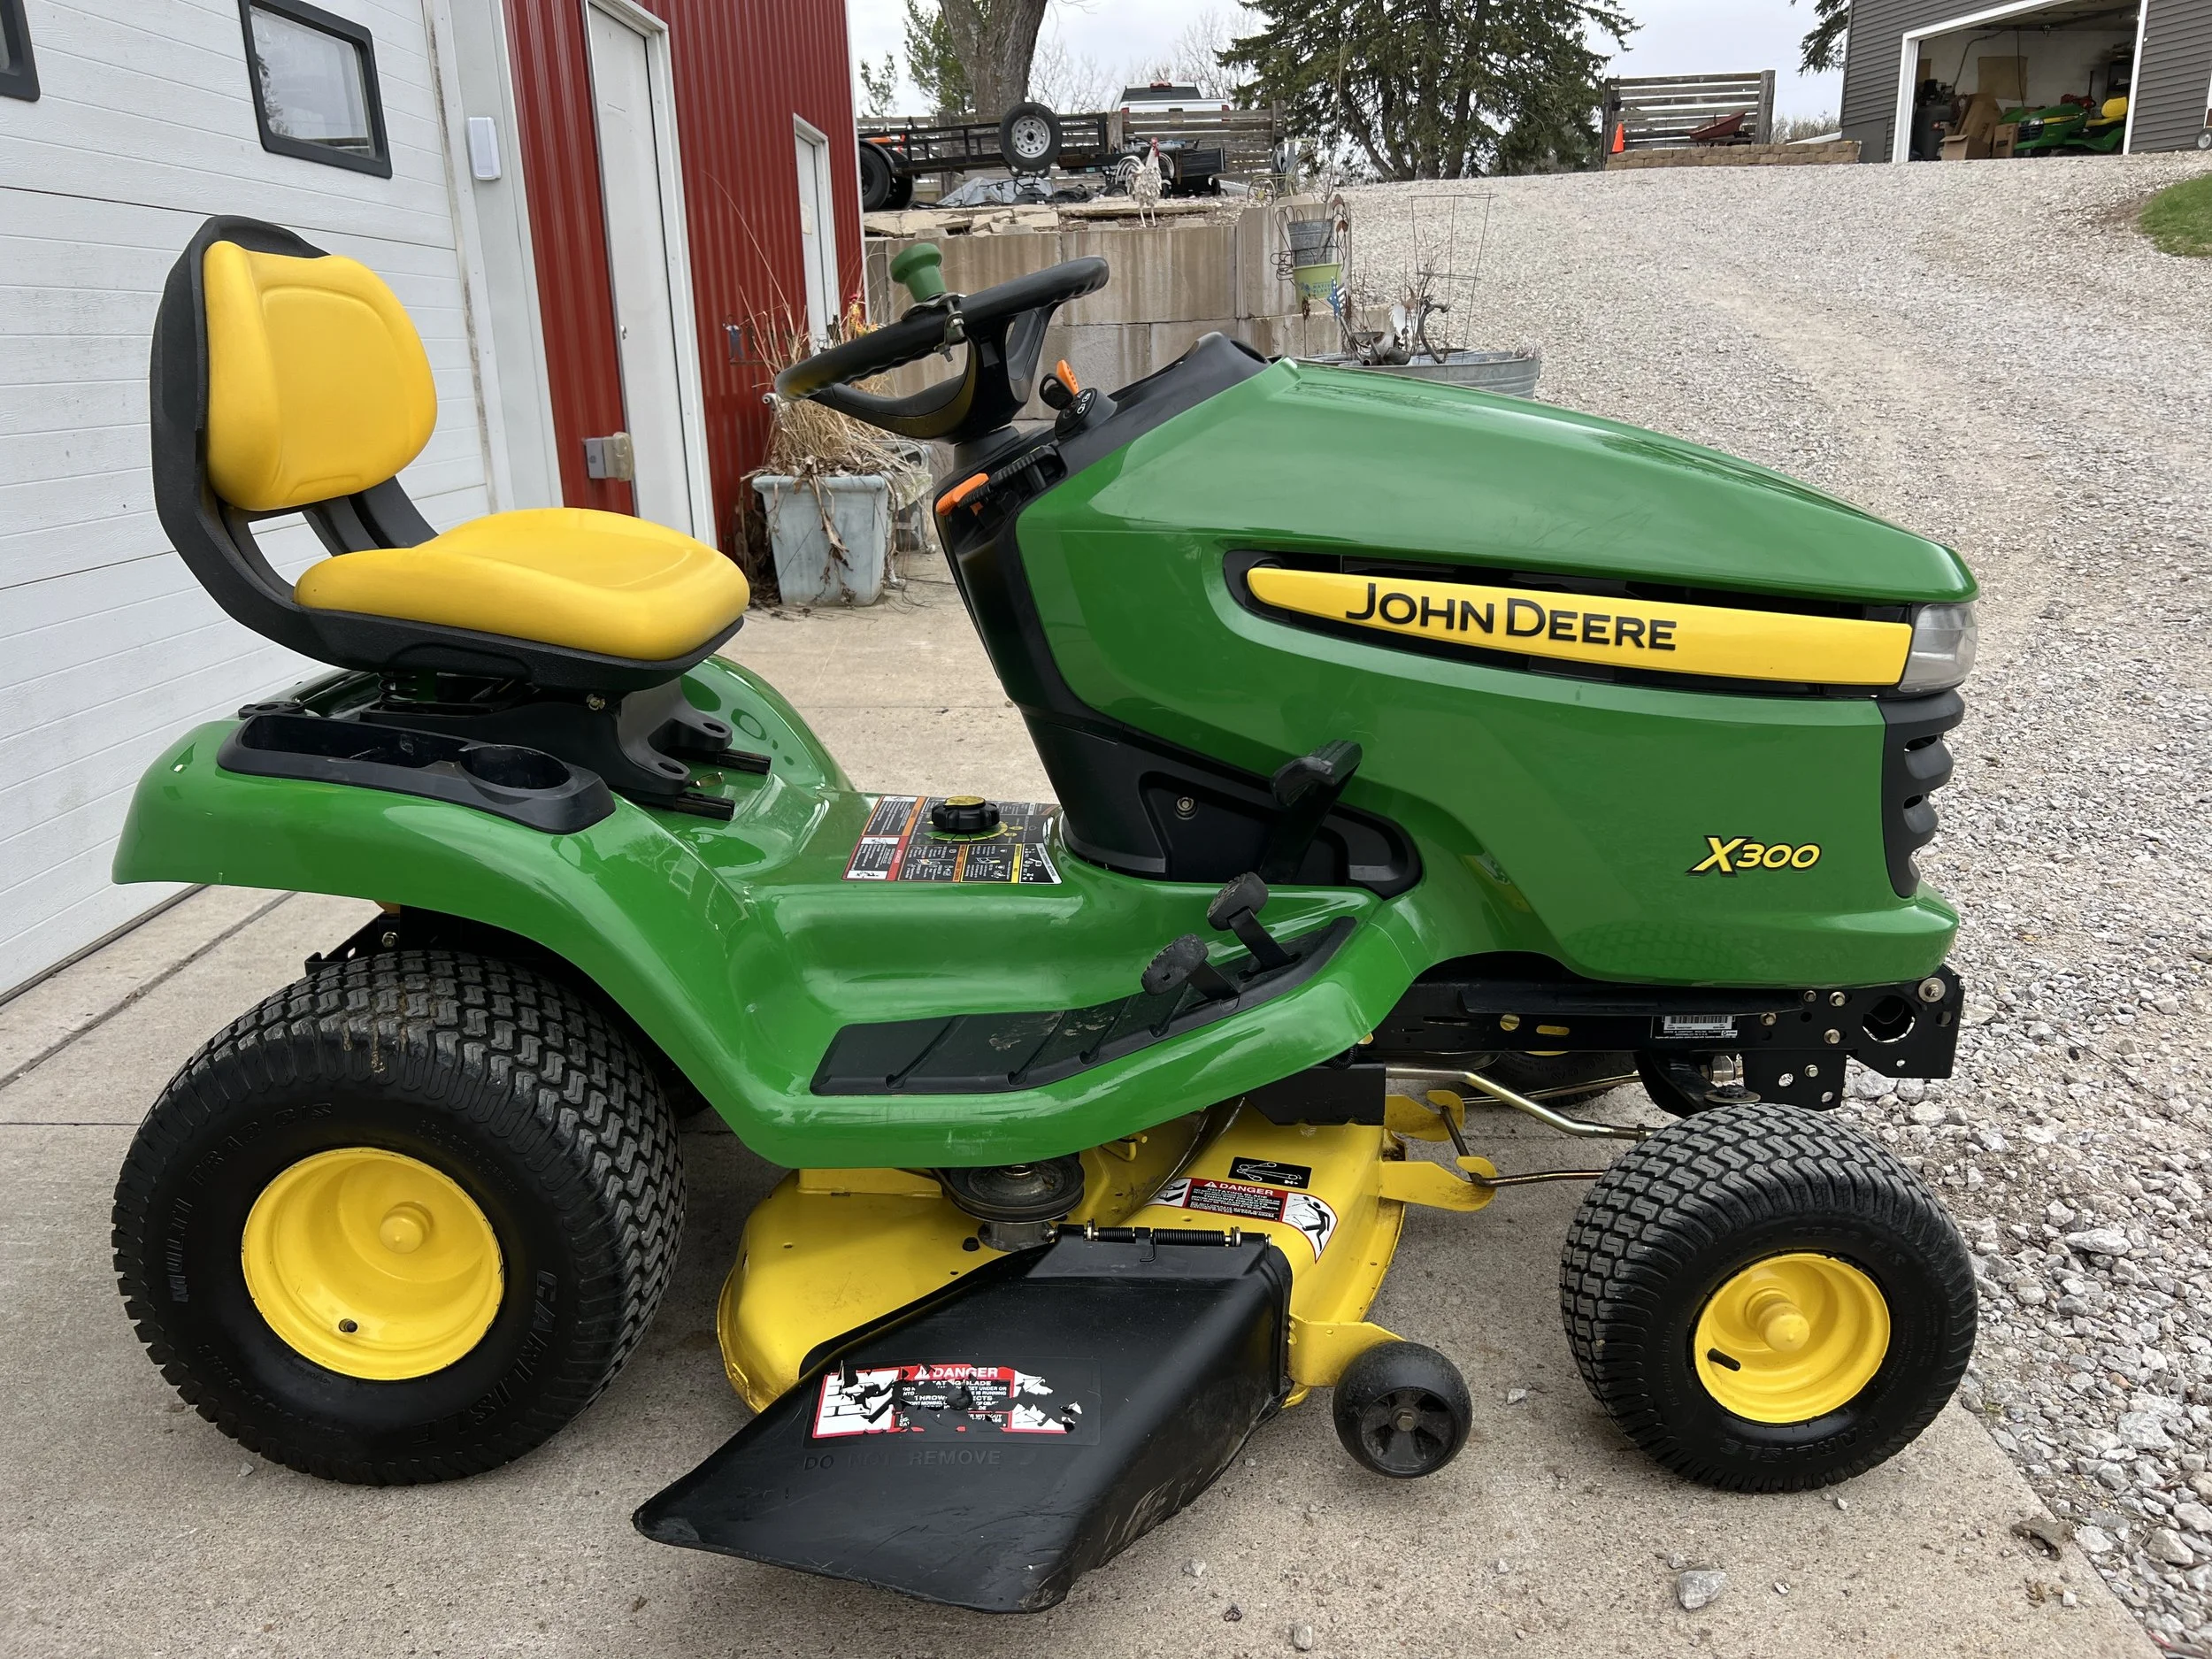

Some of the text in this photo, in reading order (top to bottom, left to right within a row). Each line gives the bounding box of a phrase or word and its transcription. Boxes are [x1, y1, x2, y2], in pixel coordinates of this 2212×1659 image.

[1346, 582, 1677, 651] JOHN DEERE
[1685, 835, 1823, 877] X300
[1219, 1183, 1274, 1195] DANGER
[933, 1367, 998, 1378] DANGER
[804, 1454, 834, 1471] DO
[909, 1450, 1002, 1466] REMOVE
